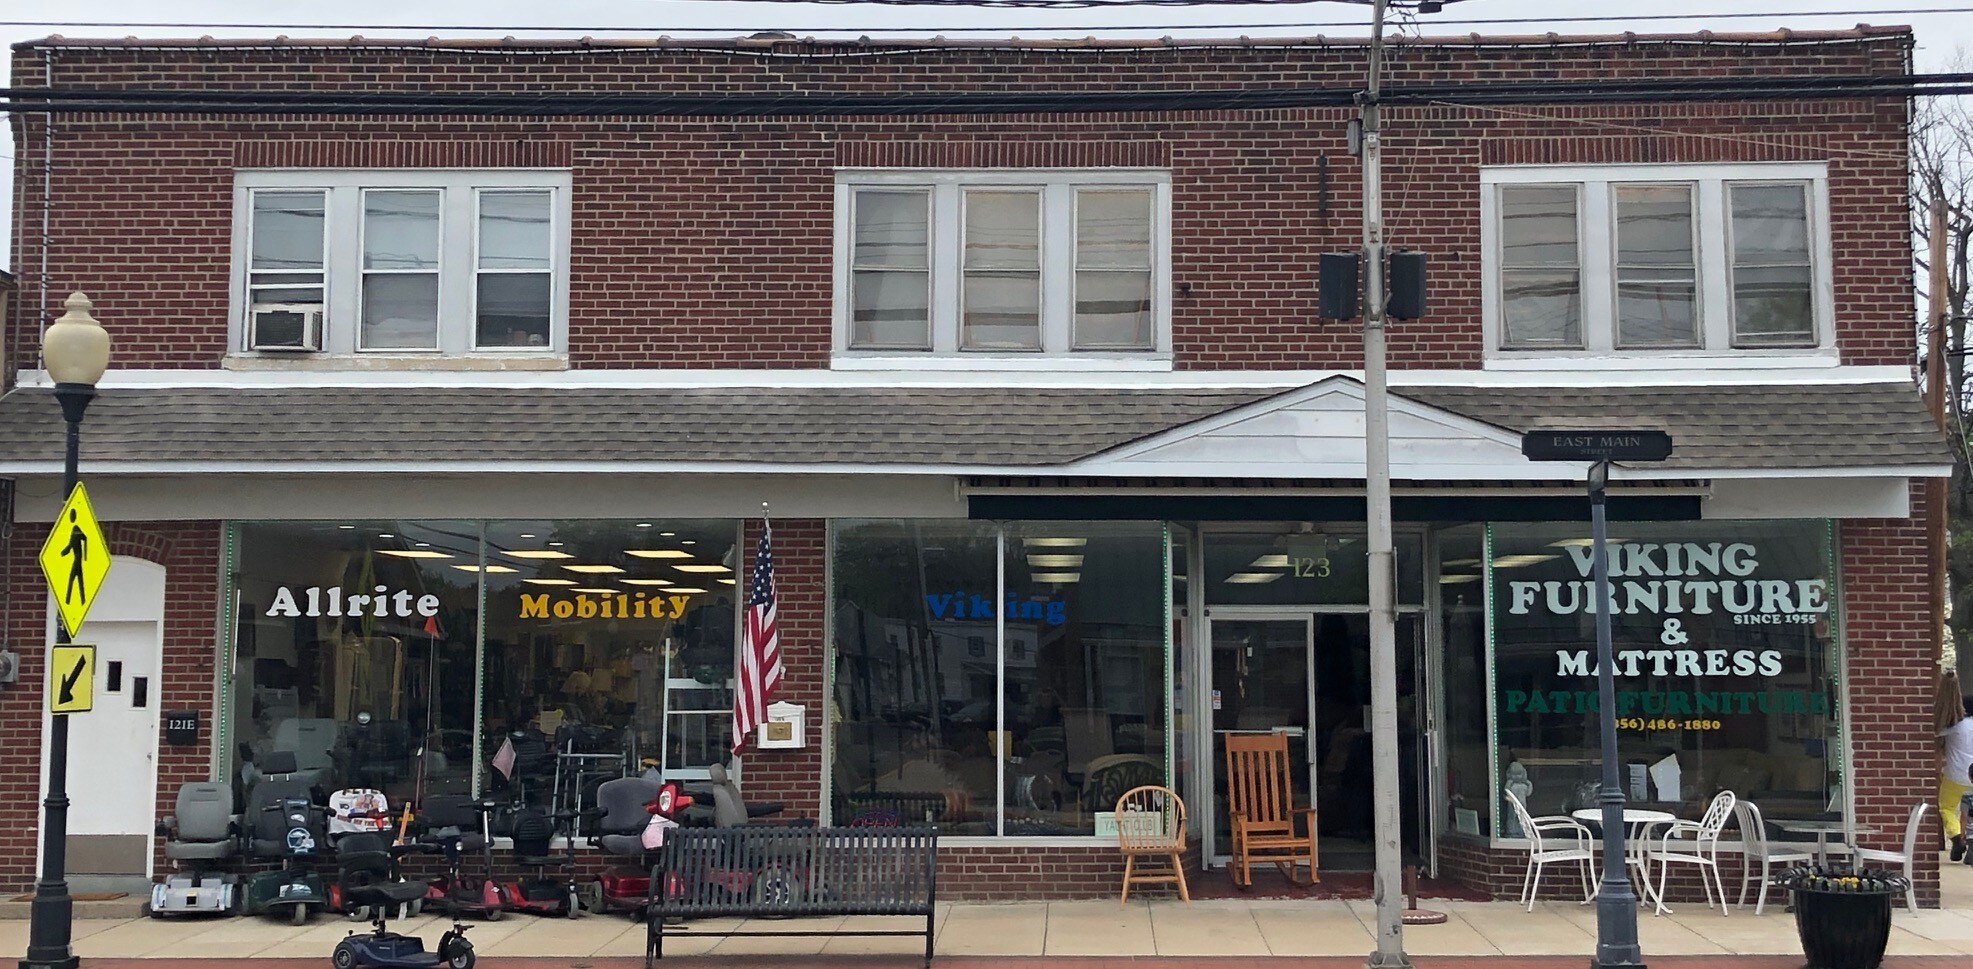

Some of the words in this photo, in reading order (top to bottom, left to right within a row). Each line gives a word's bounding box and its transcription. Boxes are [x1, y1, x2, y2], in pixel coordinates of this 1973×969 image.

[1553, 436, 1593, 447] EAST
[1600, 436, 1641, 447] MAIN
[1293, 557, 1331, 578] 123
[1564, 543, 1759, 578] VIKING
[265, 585, 441, 617] Allrite
[518, 591, 691, 619] Mobility
[925, 591, 1066, 625] Viking
[1508, 579, 1829, 615] FURNITURE
[1659, 618, 1689, 645] &
[1733, 614, 1781, 625] SINCE
[1785, 614, 1817, 624] 1955
[1616, 689, 1830, 715] FURNITURE
[169, 719, 195, 730] 121E
